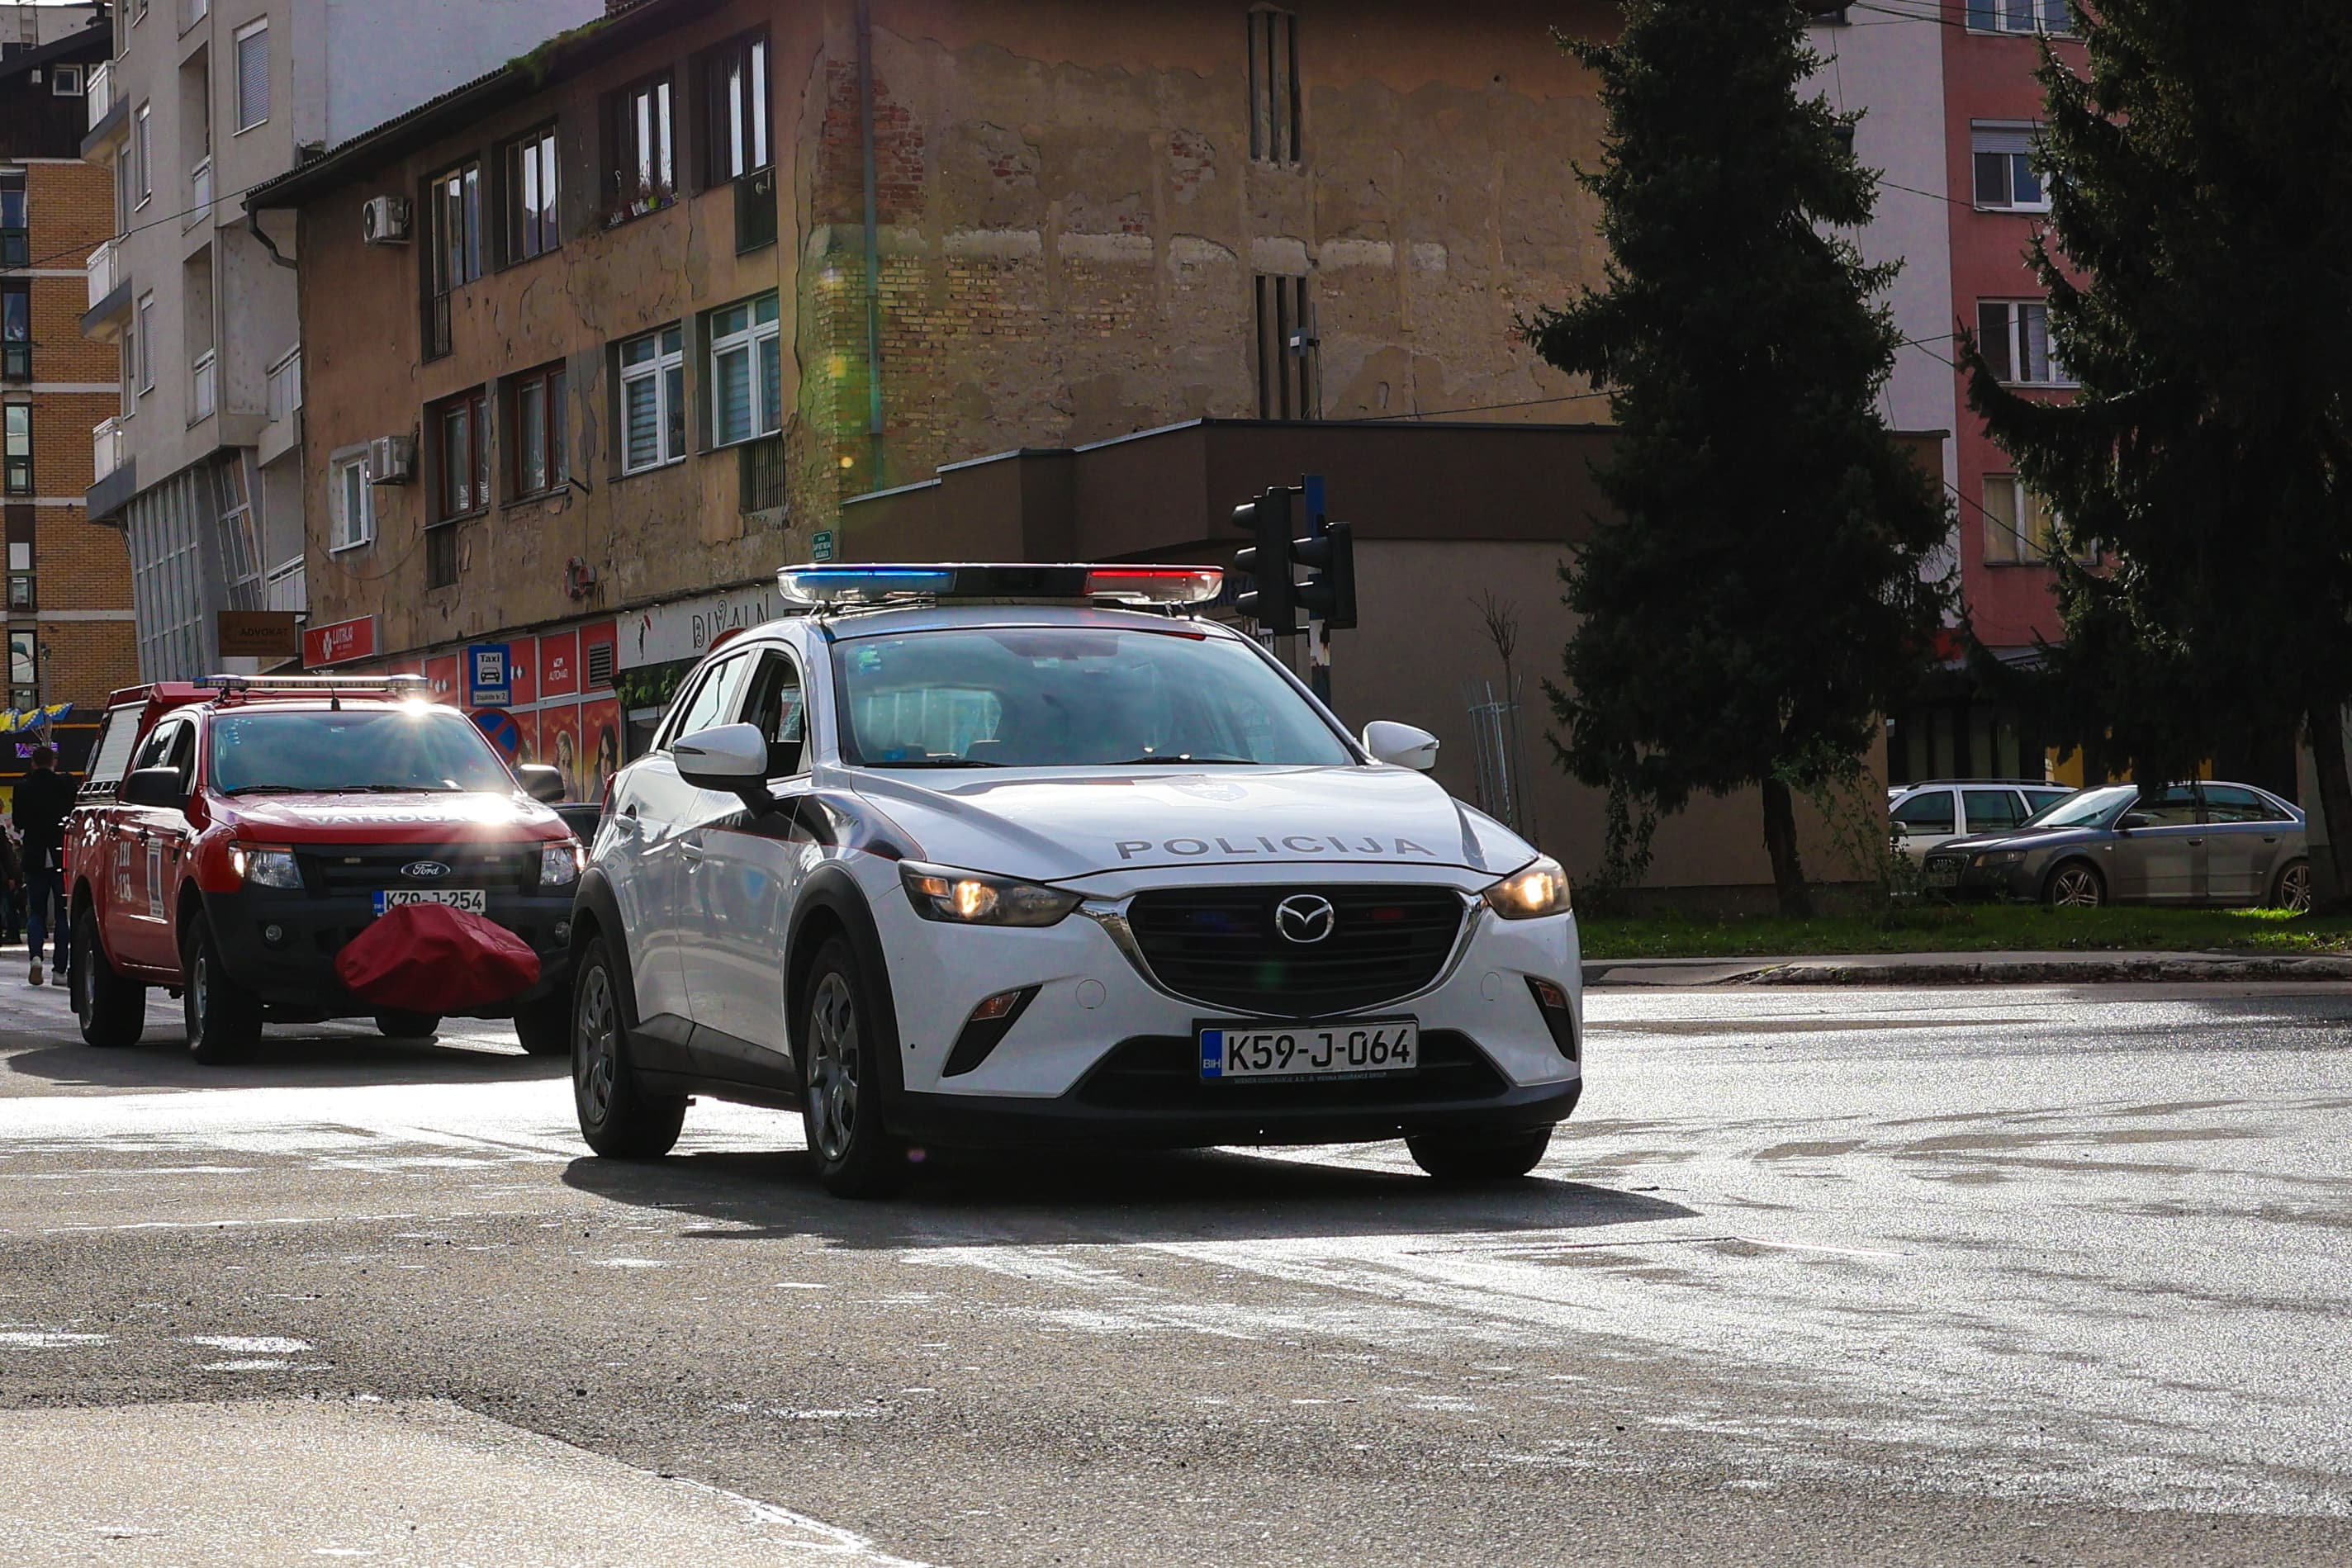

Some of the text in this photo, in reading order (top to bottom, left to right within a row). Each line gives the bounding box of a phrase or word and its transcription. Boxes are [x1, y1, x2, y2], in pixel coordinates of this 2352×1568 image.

[239, 628, 288, 636] ADVOKAT
[479, 654, 500, 663] Taxi
[501, 692, 507, 700] 2
[308, 814, 487, 825] VATROGA
[1115, 836, 1437, 860] POLICIJA
[412, 864, 439, 875] Ford
[1203, 1030, 1411, 1071] BIH K59-J-064
